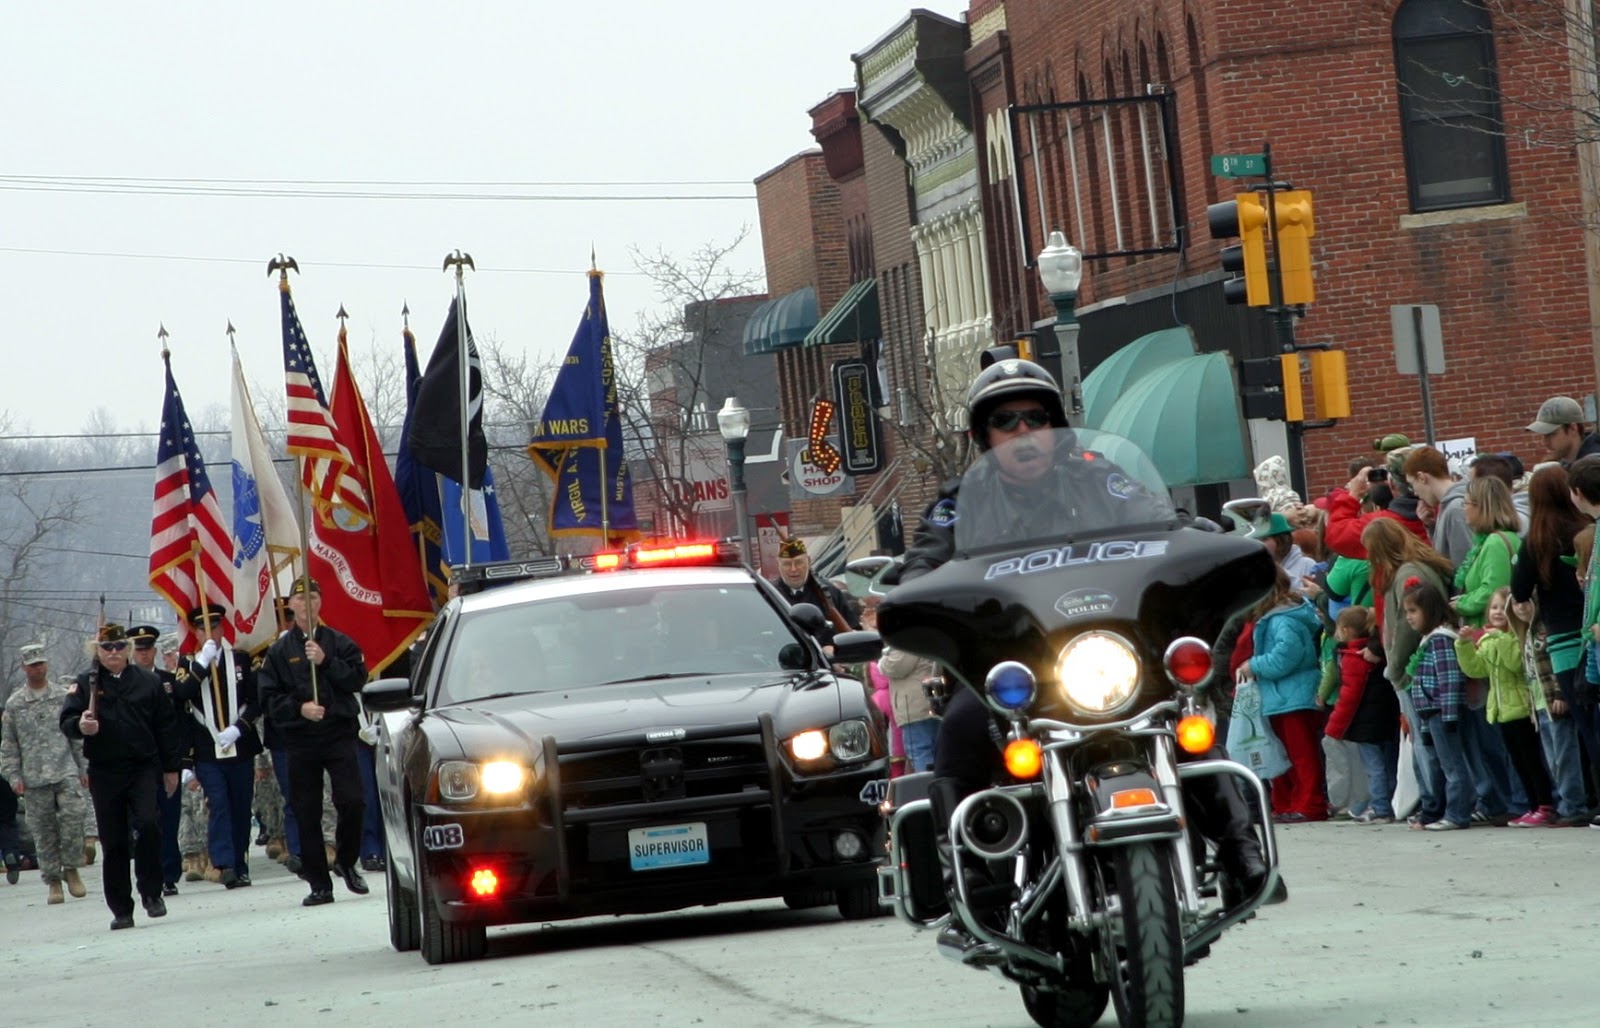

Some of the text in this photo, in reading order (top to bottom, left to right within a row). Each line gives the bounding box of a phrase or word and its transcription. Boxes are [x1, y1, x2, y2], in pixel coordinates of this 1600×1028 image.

[548, 418, 589, 436] WARS
[804, 475, 841, 487] SHOP
[567, 477, 587, 523] VIRGIL
[984, 540, 1169, 580] POLICE
[314, 543, 379, 603] MARINE CORPS
[1067, 603, 1110, 615] POLICE
[423, 823, 464, 850] 408
[634, 838, 704, 858] SUPERVISOR
